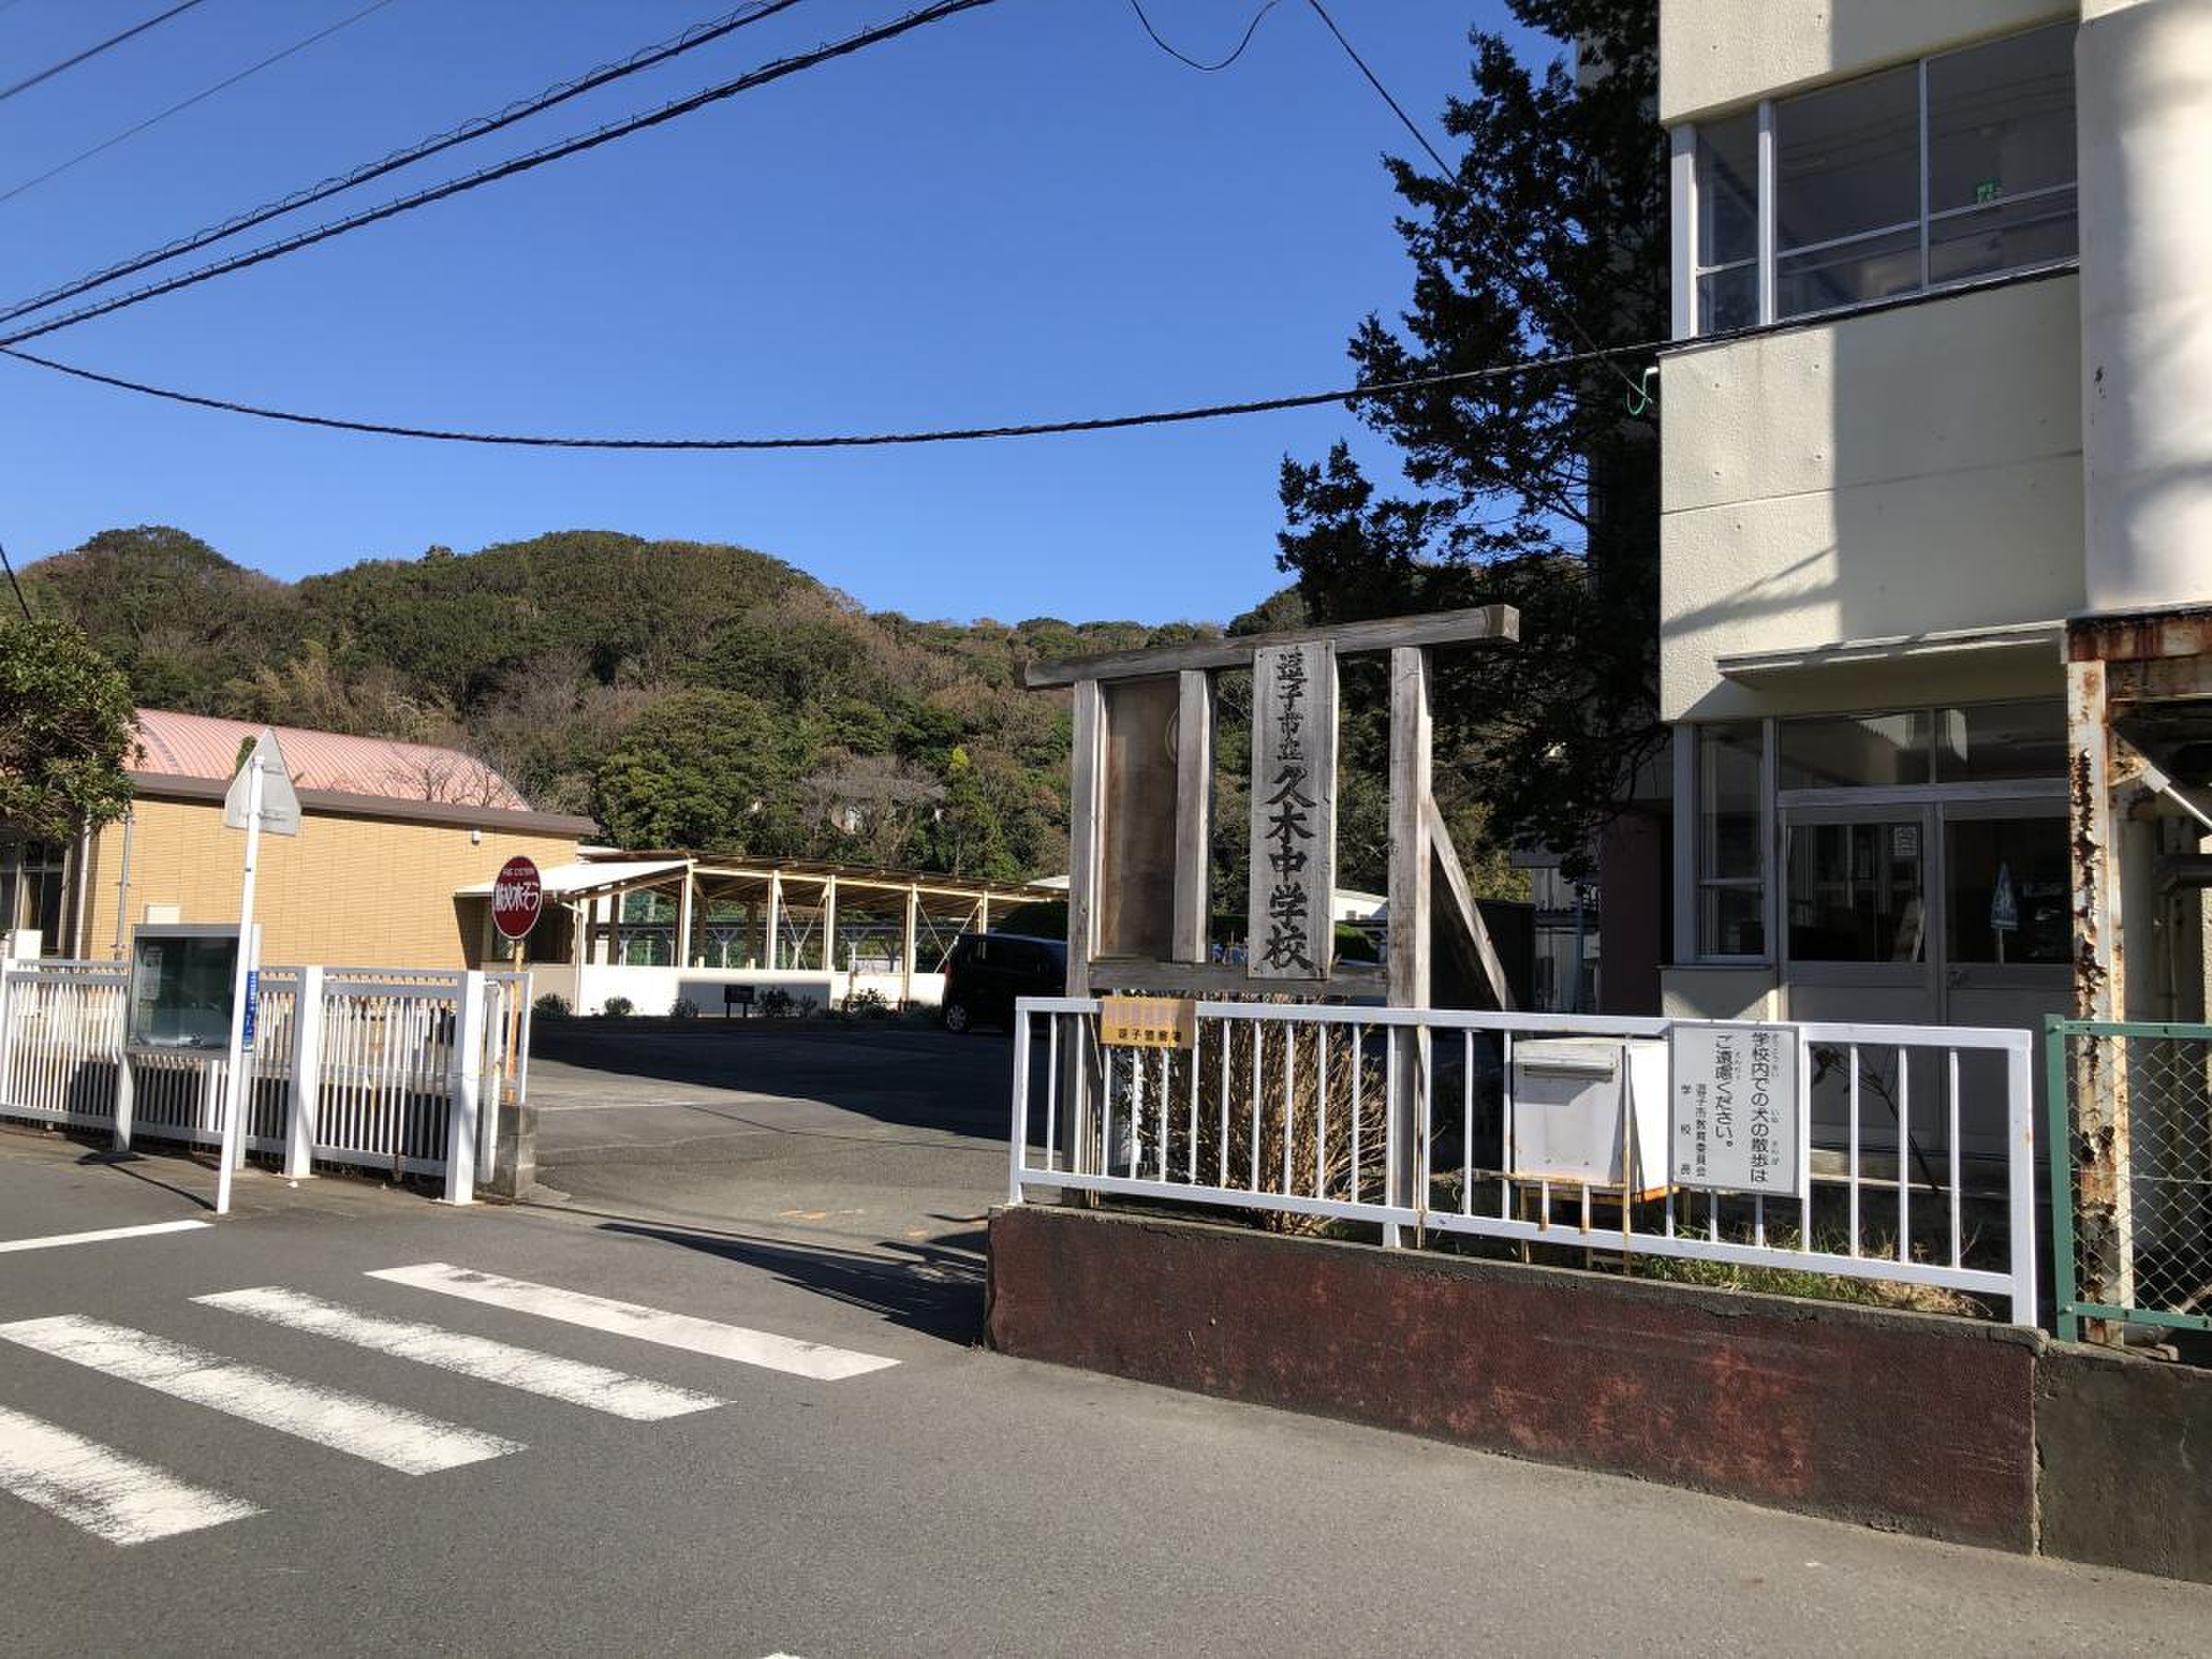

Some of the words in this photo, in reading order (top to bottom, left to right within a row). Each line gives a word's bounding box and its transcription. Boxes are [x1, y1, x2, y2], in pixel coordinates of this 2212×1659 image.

[1264, 646, 1317, 971] 逗子市立久木中学校
[1715, 1034, 1734, 1147] ご遠慮ください。
[1751, 1031, 1770, 1182] 学校内での犬の散歩は
